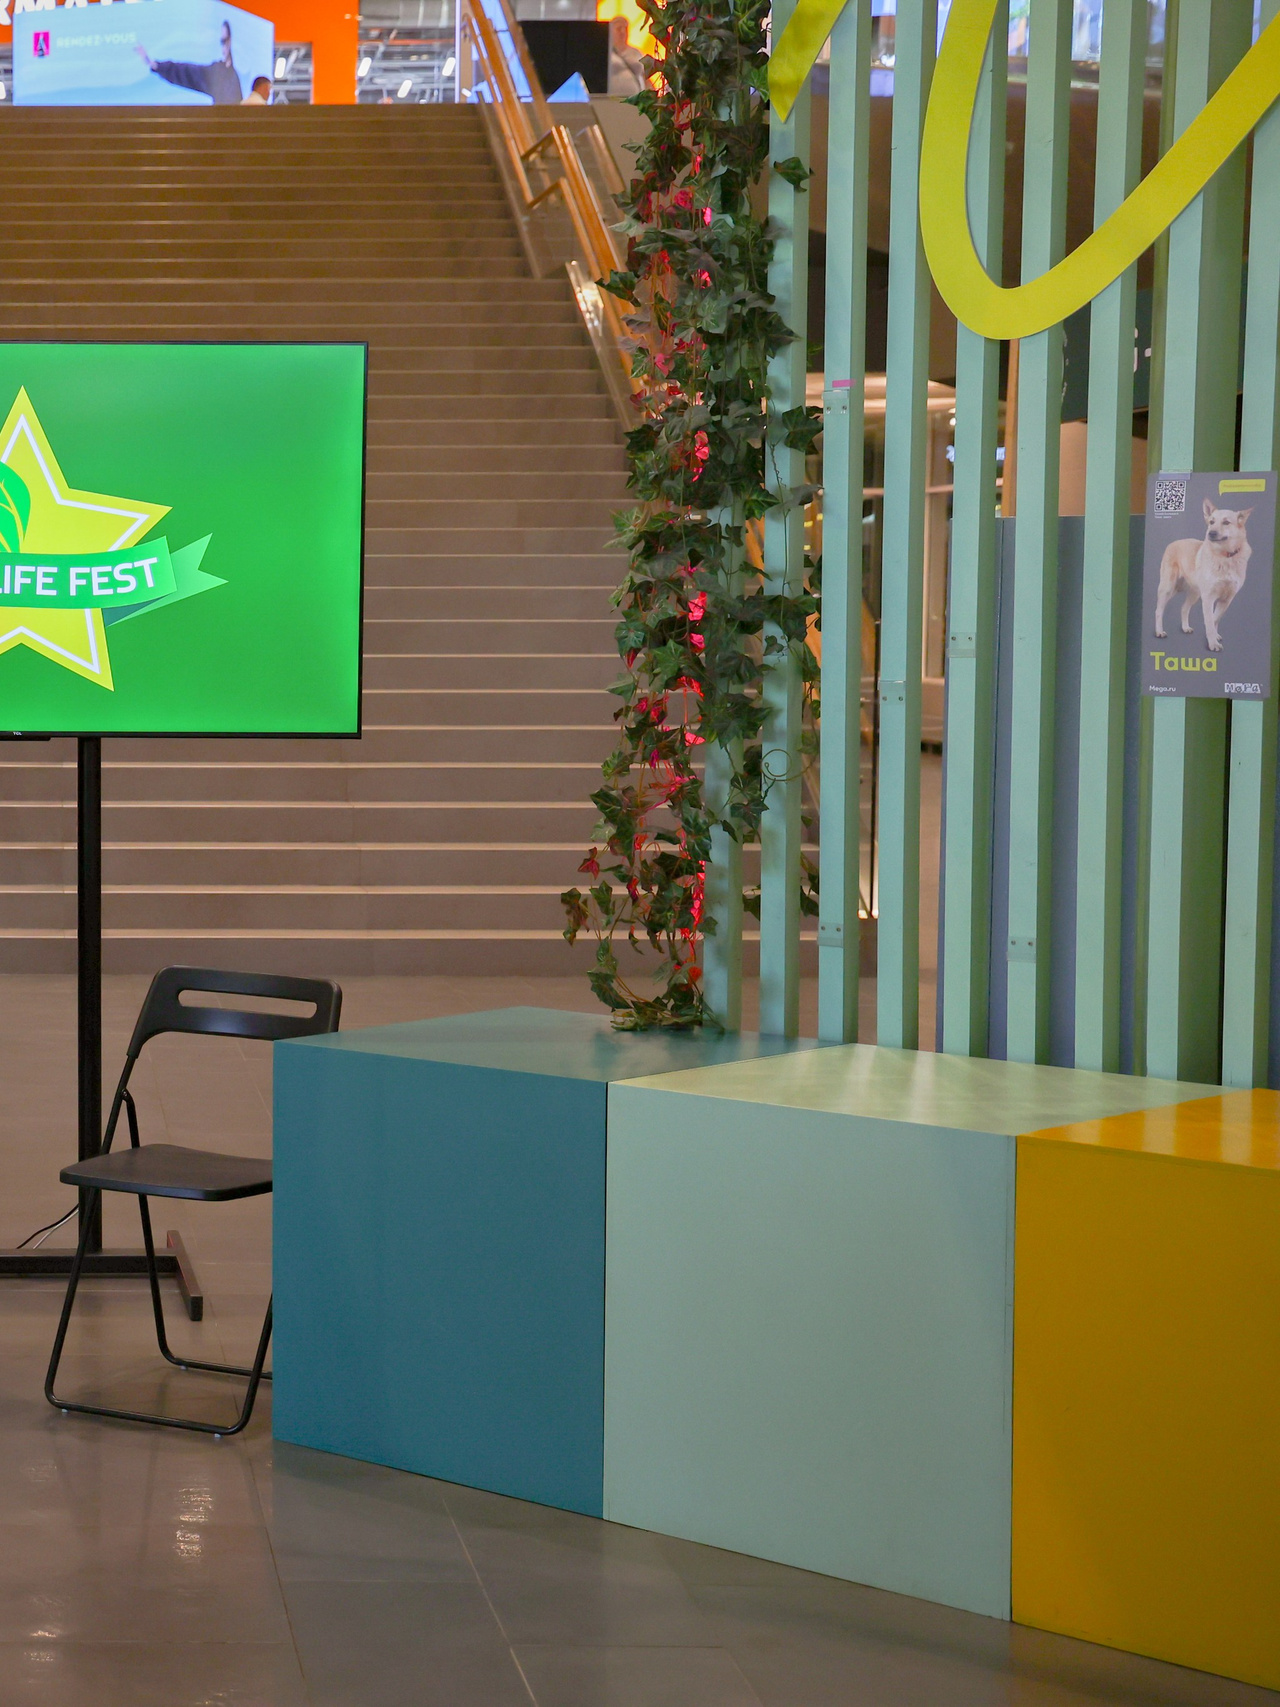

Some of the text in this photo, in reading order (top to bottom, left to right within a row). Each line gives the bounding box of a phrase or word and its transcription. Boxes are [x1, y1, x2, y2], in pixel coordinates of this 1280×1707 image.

[69, 556, 159, 597] FEST
[1149, 651, 1218, 672] Таша
[1148, 685, 1177, 693] Mega.ru
